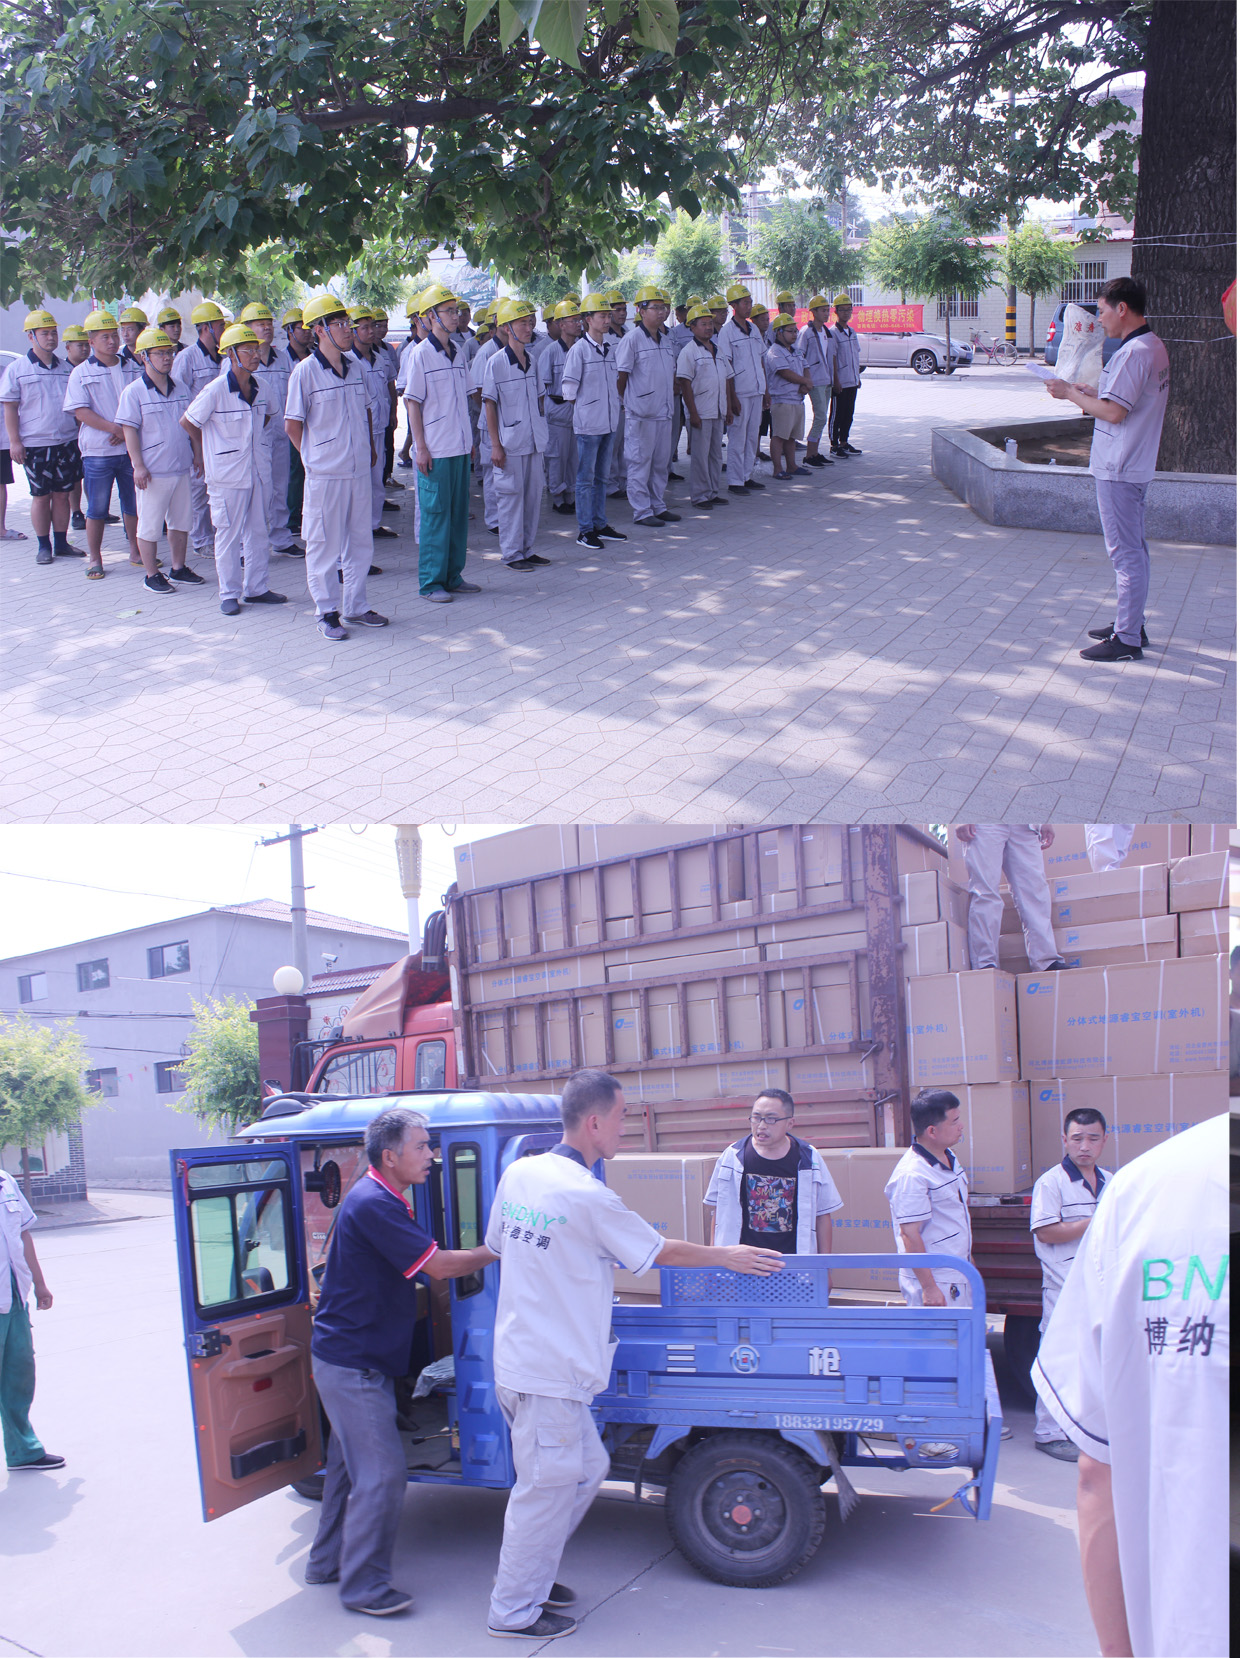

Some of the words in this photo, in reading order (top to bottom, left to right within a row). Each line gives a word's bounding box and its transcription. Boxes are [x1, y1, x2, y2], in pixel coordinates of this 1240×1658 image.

[1142, 1254, 1230, 1301] BN
[1144, 1315, 1215, 1356] 博纳
[666, 1344, 697, 1374] 三
[809, 1346, 841, 1376] 枪
[774, 1414, 884, 1433] 18833195729
